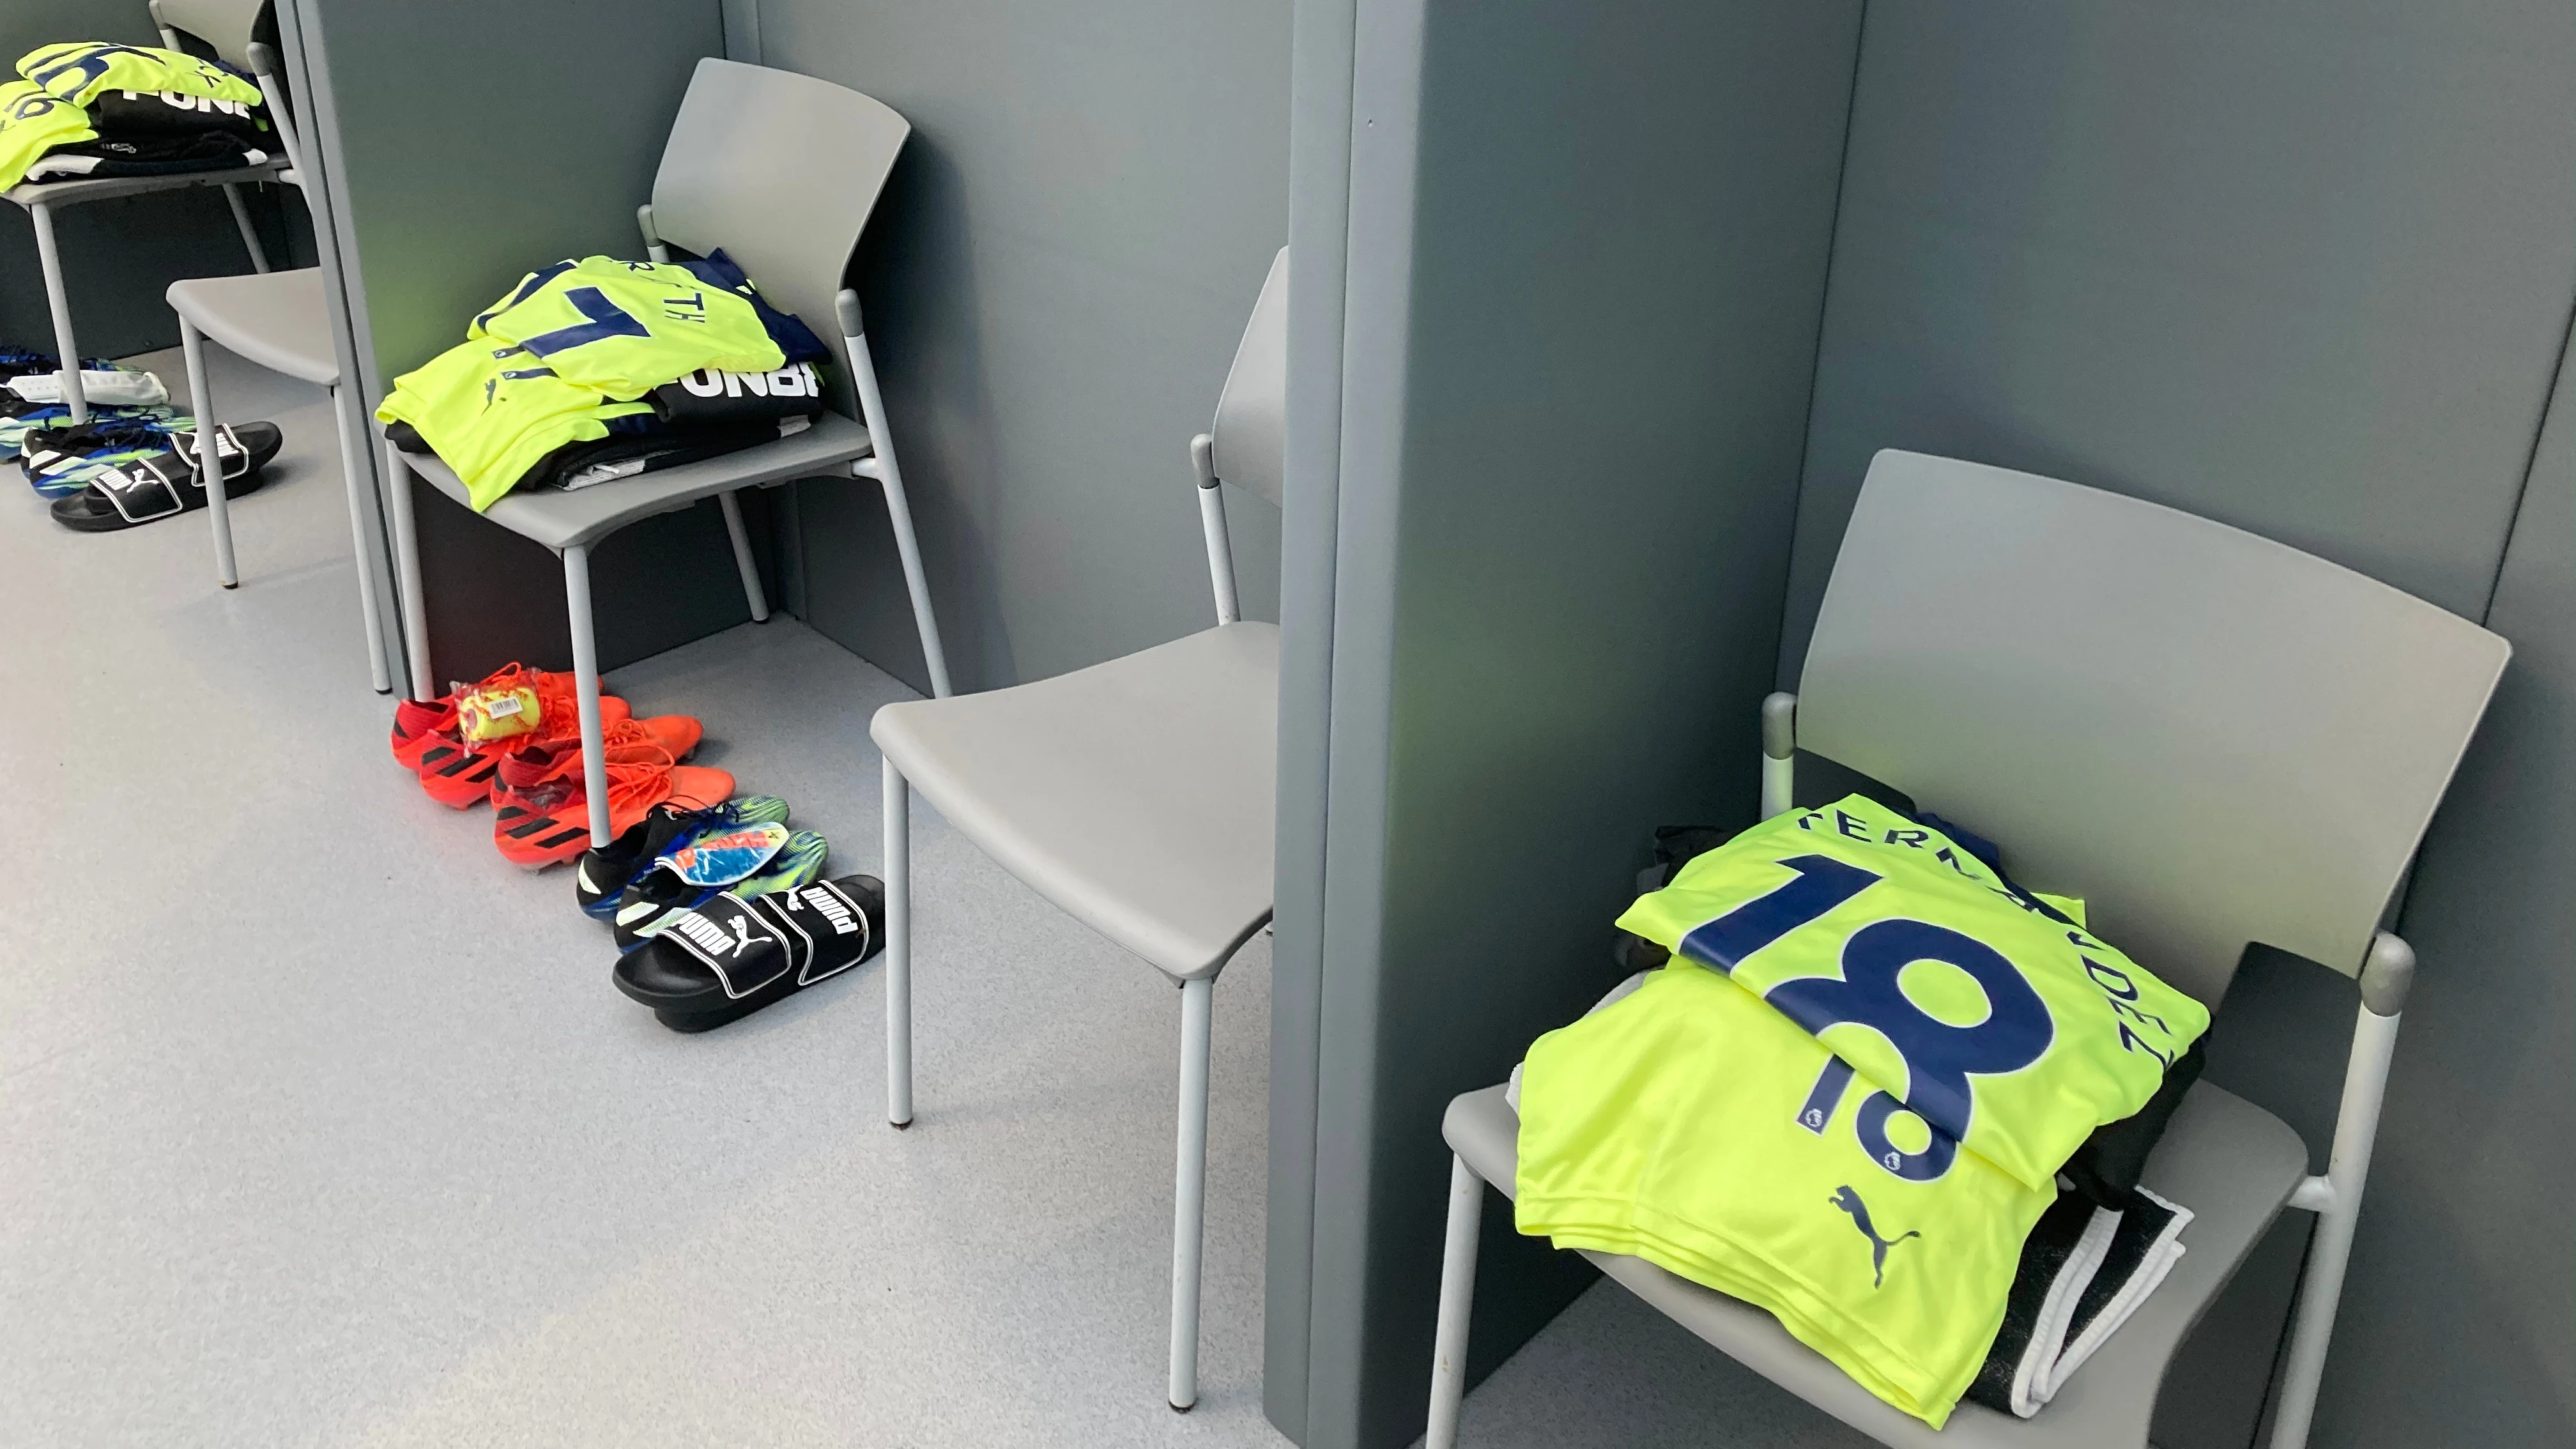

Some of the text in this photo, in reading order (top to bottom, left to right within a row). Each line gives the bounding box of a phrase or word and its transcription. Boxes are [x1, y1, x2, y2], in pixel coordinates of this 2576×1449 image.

[670, 911, 736, 956] PUMA
[799, 886, 859, 935] PUMA
[1676, 852, 2055, 1144] 18
